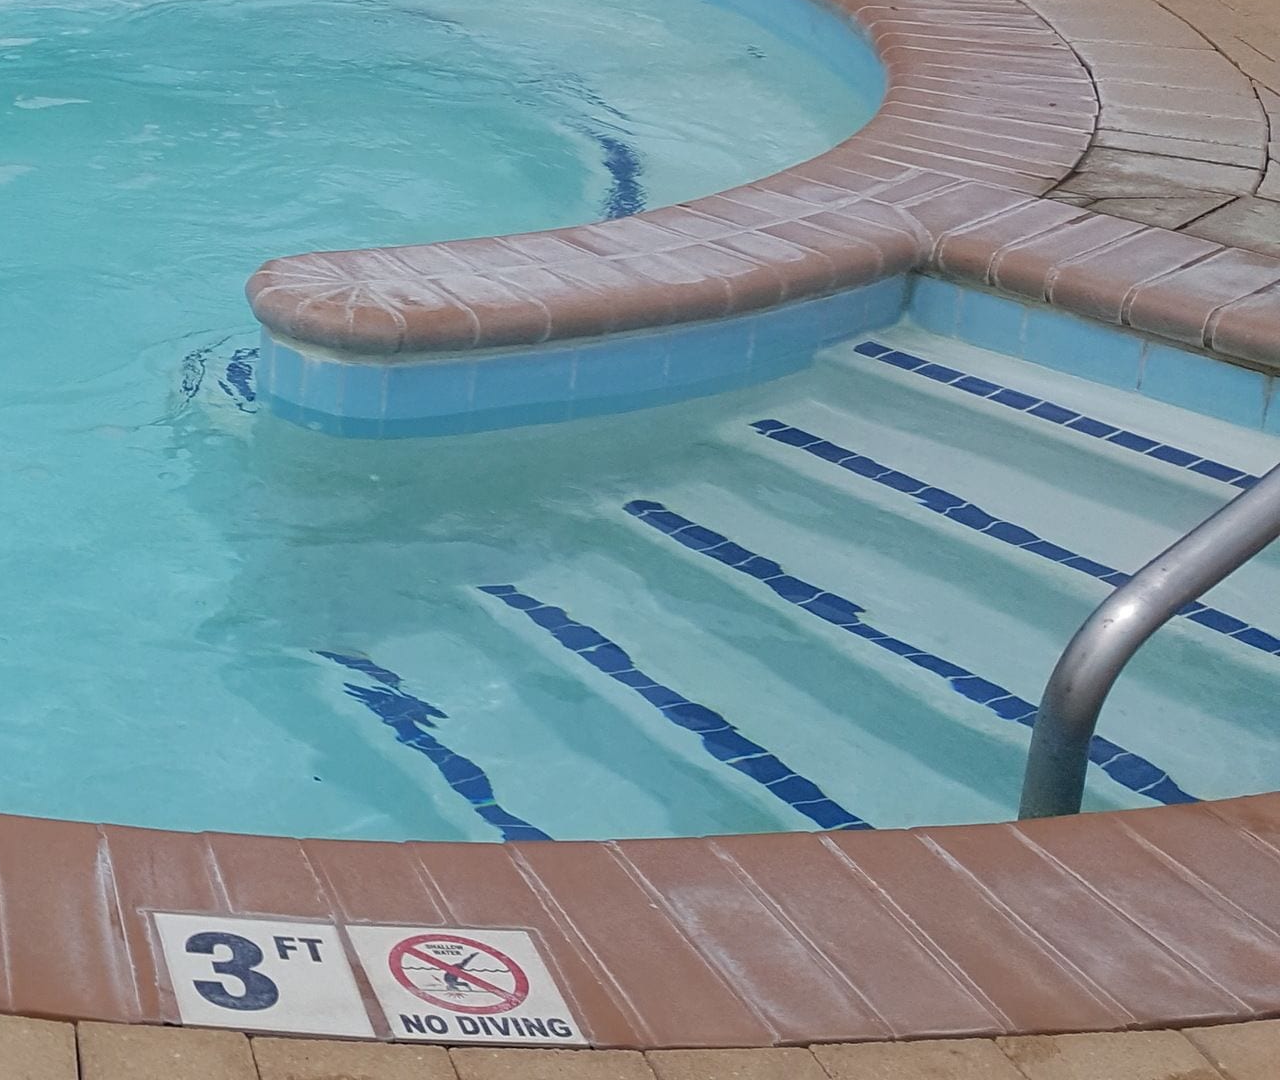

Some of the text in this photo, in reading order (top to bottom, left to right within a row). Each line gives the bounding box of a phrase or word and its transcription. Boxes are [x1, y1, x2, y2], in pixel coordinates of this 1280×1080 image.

[185, 931, 324, 1011] 3 FT
[399, 1014, 573, 1039] NO DIVING
